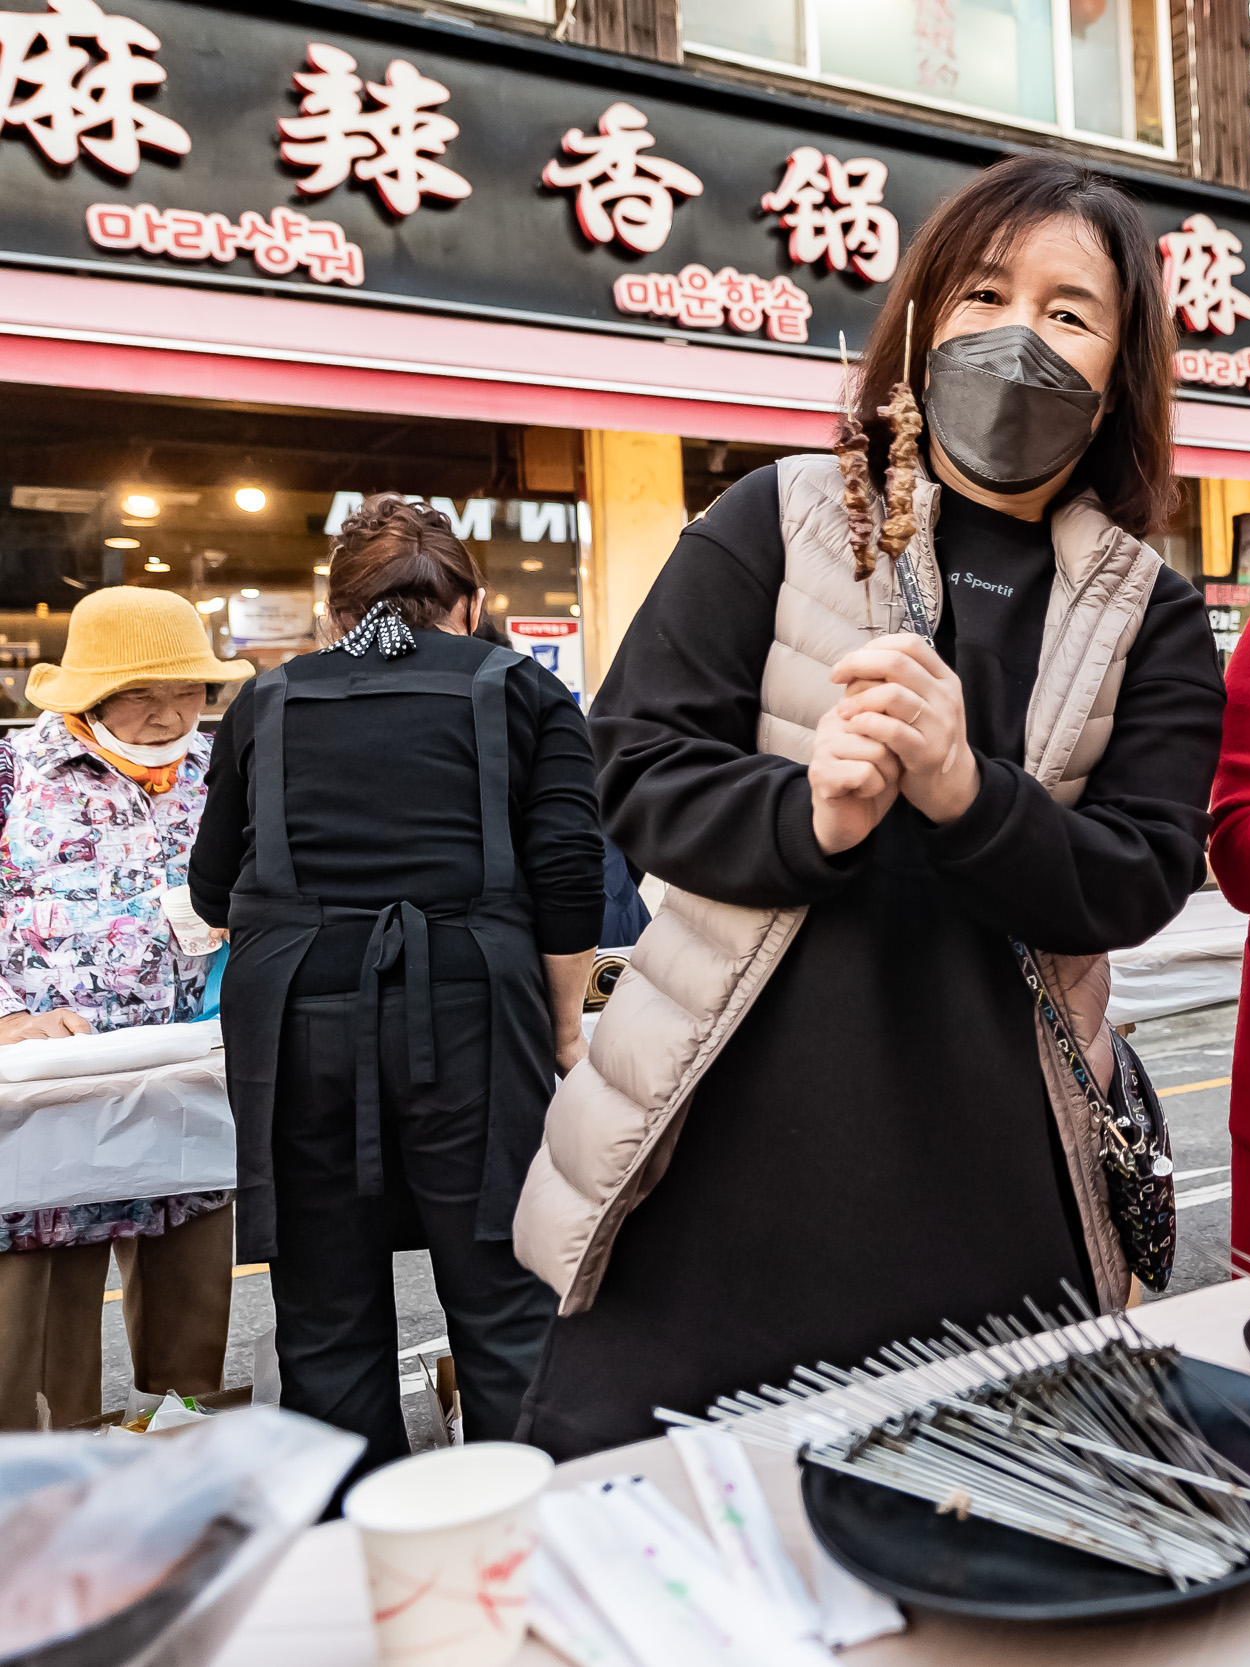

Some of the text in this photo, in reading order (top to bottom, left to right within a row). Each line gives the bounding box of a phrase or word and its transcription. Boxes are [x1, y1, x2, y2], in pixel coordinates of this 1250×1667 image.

[86, 203, 365, 286] 마라샹궈
[613, 264, 813, 343] 매운향솥
[963, 571, 1014, 598] Sportif
